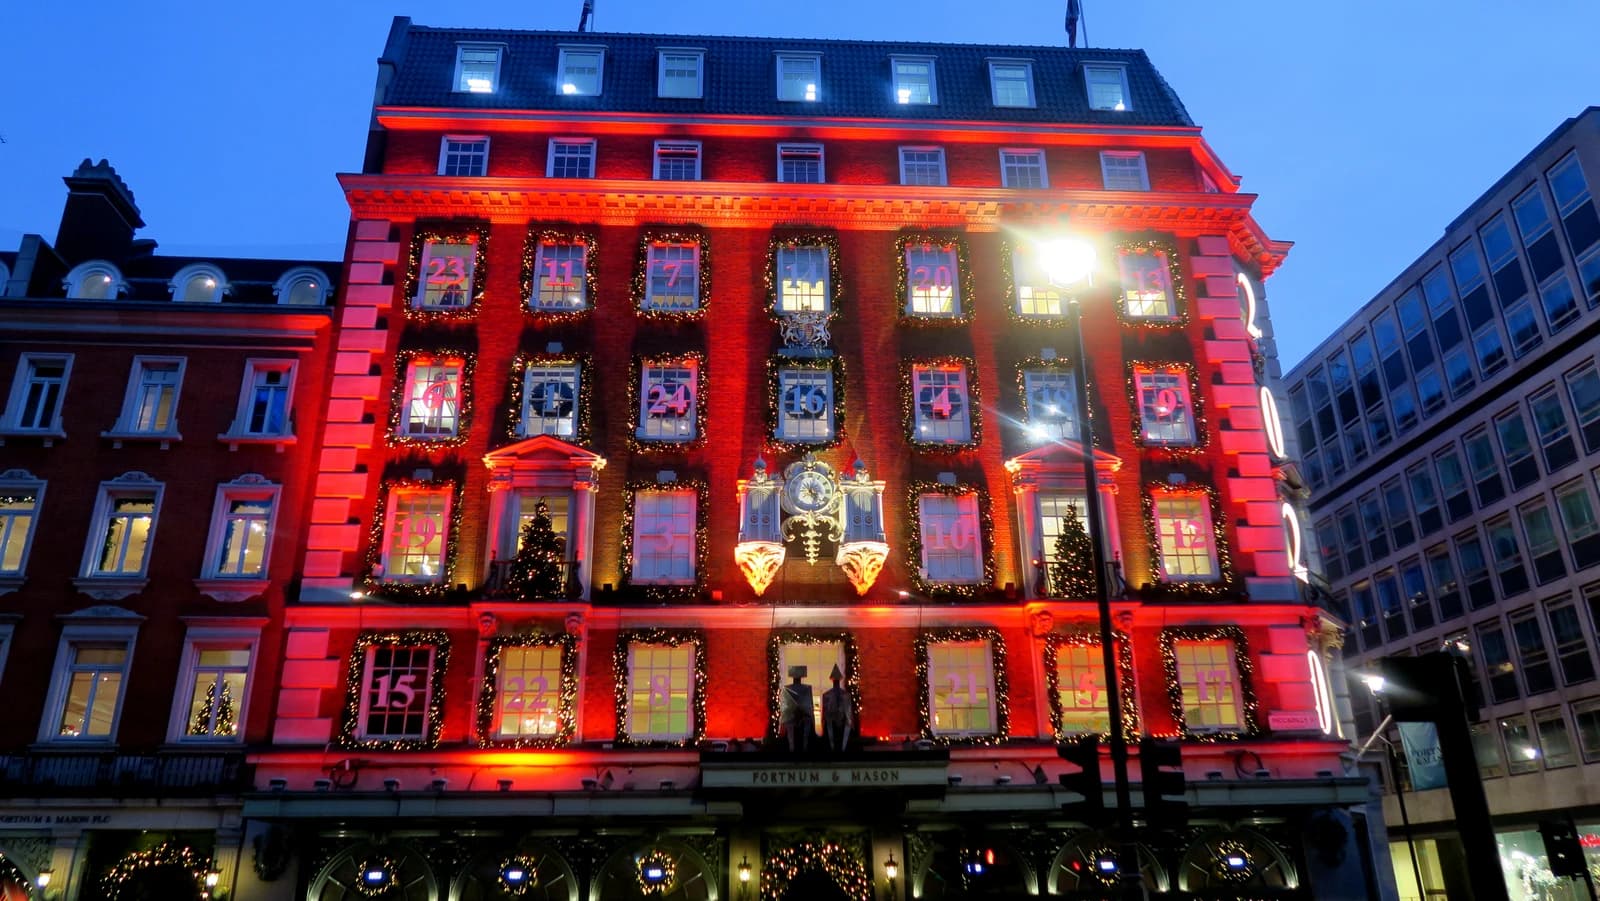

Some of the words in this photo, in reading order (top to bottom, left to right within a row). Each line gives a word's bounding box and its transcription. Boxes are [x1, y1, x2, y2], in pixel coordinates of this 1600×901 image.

[428, 256, 465, 285] 23
[543, 257, 577, 287] 11
[662, 262, 682, 287] 7
[915, 265, 953, 291] 20
[541, 383, 557, 413] 1
[648, 384, 691, 414] 24
[789, 385, 825, 416] 16
[930, 387, 951, 417] 4
[1157, 388, 1178, 417] 9
[398, 517, 436, 549] 19
[655, 522, 675, 551] 3
[931, 518, 970, 550] 10
[1170, 519, 1206, 549] 12
[374, 674, 417, 708] 15
[507, 676, 550, 710] 22
[650, 674, 671, 708] 8
[945, 672, 979, 705] 21
[1077, 671, 1099, 706] 5
[1195, 669, 1228, 701] 17
[752, 771, 820, 784] FORTNUM
[832, 771, 840, 783] &
[851, 770, 900, 783] MASON
